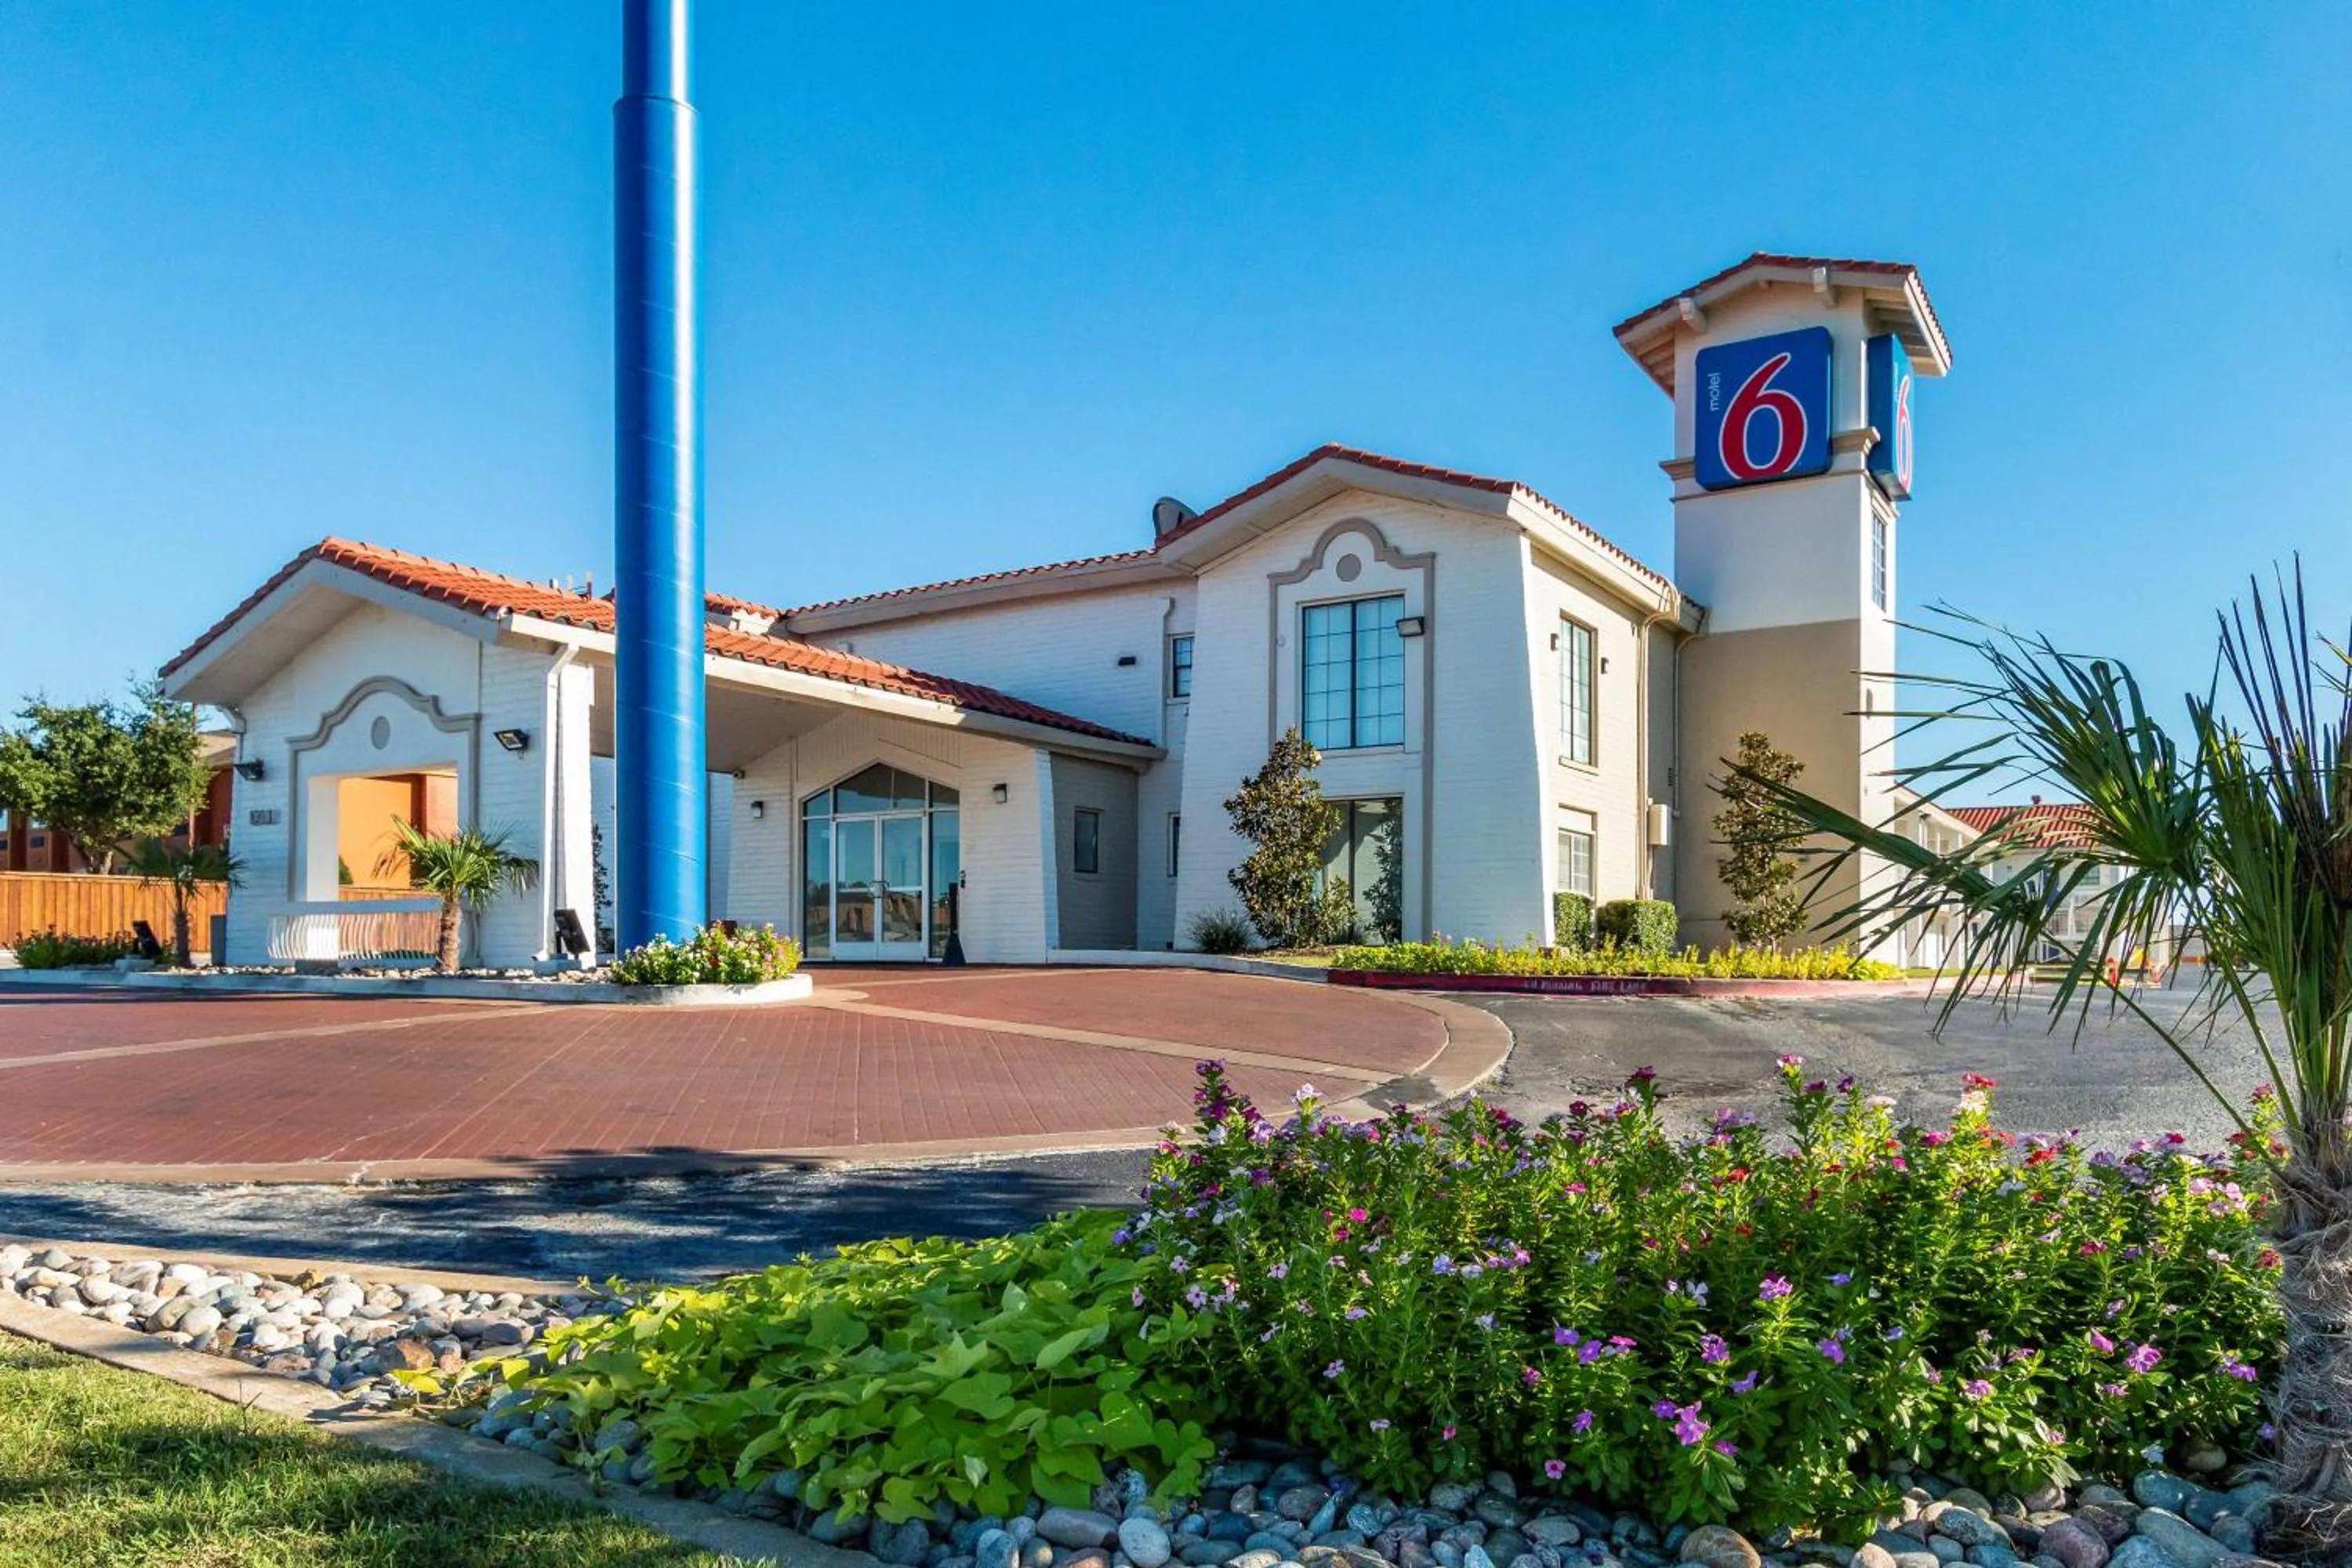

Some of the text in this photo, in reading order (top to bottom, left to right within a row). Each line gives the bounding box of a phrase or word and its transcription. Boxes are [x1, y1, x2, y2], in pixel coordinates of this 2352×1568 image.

[1708, 372, 1720, 412] motel
[1719, 352, 1808, 479] 6
[1896, 375, 1912, 493] 6
